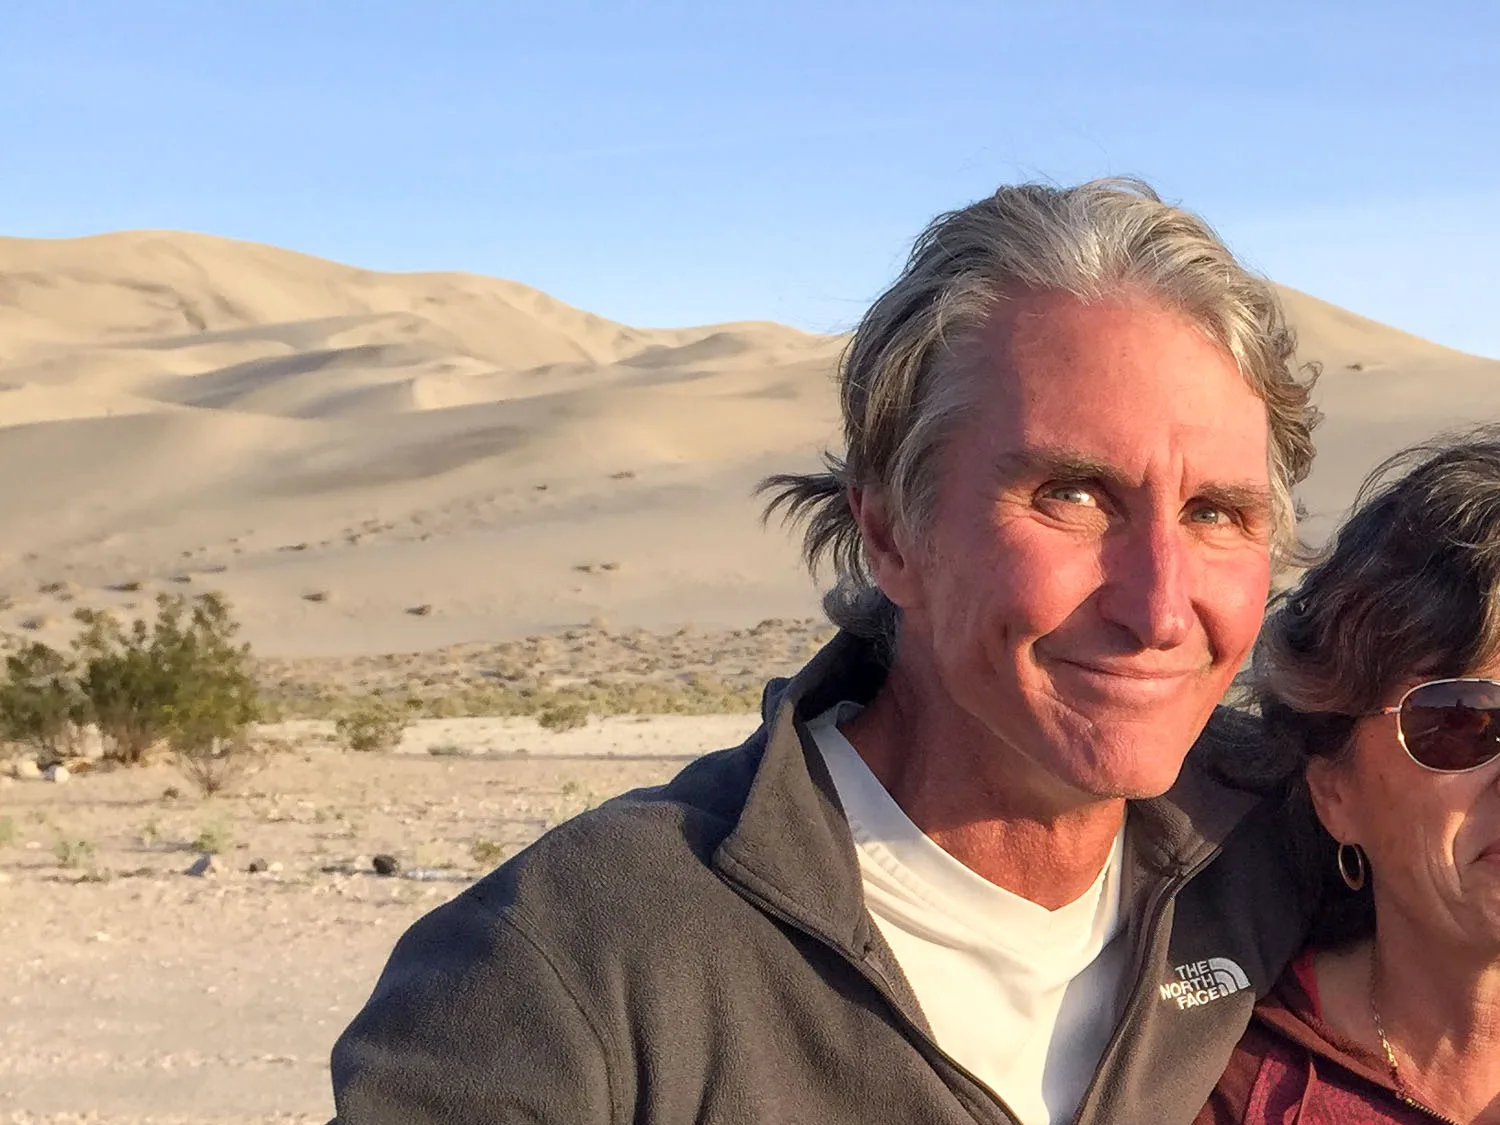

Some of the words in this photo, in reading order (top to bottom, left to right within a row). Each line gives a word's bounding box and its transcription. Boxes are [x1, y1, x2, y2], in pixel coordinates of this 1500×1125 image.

[1175, 961, 1210, 980] THE
[1160, 974, 1215, 1000] NORTH
[1177, 987, 1220, 1010] FACE
